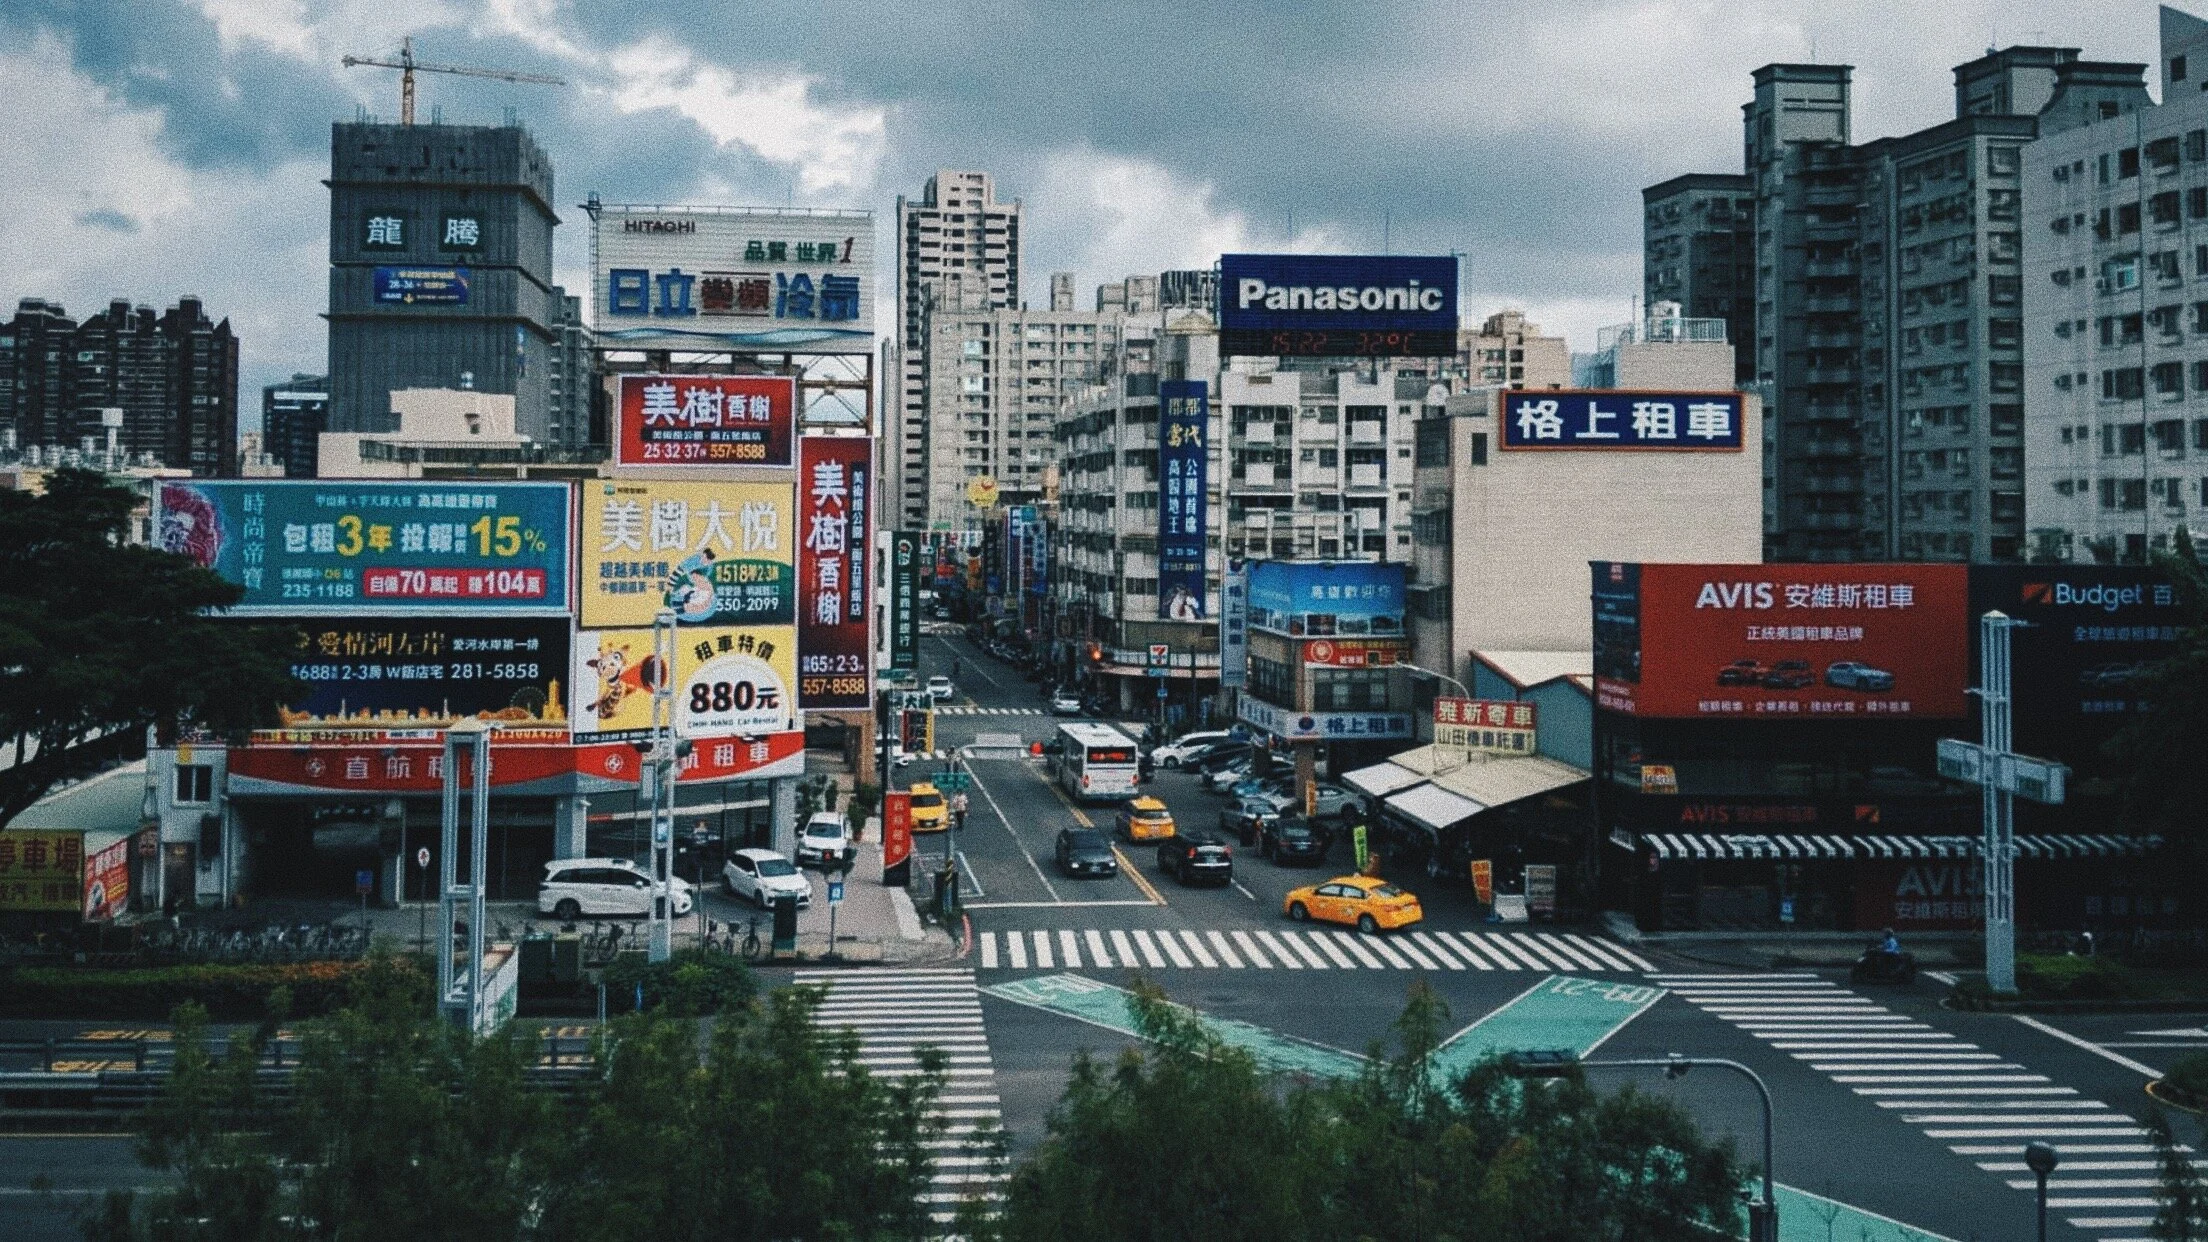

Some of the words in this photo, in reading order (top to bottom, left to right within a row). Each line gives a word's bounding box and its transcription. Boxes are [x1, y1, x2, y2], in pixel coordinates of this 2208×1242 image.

[625, 221, 696, 234] HITACHI
[1239, 278, 1443, 312] Panasonic
[1517, 399, 1732, 440] 格上租車
[1695, 581, 1774, 610] AVIS
[1784, 583, 1915, 611] 安維斯租車
[2055, 583, 2143, 612] Budget
[317, 630, 446, 657] 愛情河左岸
[694, 634, 776, 664] 租車特價
[451, 663, 539, 680] 281-5858
[689, 680, 779, 714] 880元
[1680, 804, 1730, 823] AVIS
[1895, 864, 1984, 897] AVIS
